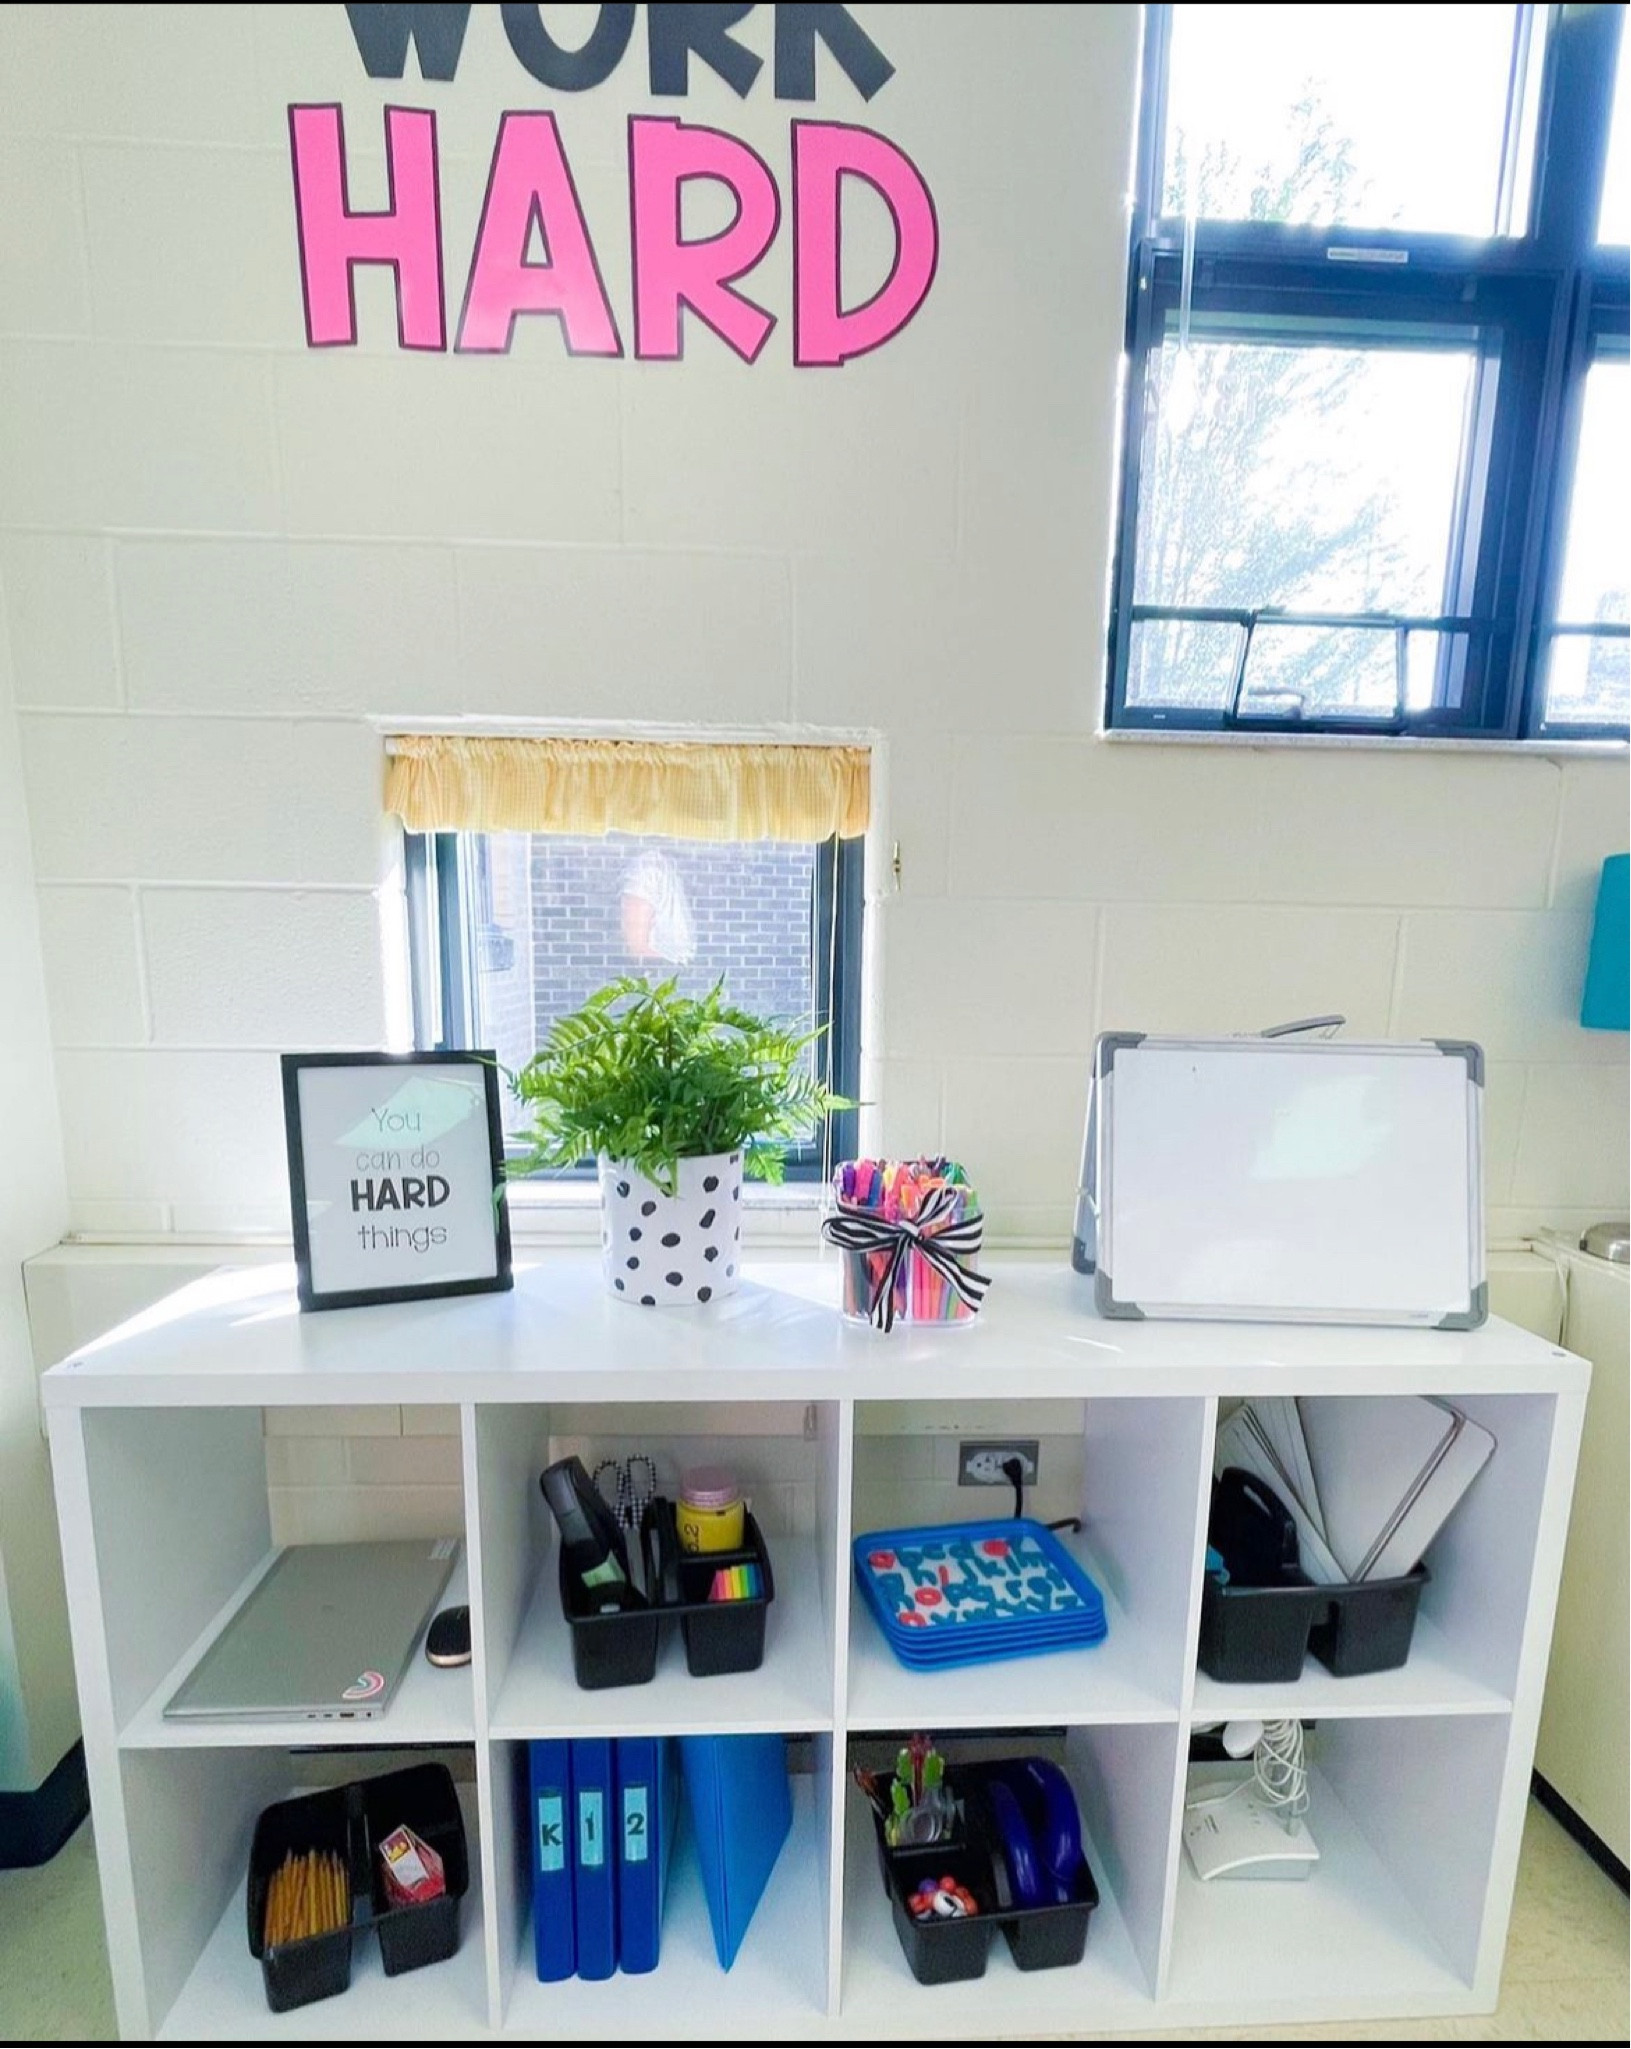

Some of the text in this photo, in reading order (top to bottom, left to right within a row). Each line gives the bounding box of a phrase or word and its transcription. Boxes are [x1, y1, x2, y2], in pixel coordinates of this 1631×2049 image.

[287, 103, 939, 367] HARD
[372, 1107, 422, 1132] You
[356, 1144, 440, 1172] can do
[350, 1175, 451, 1212] HARD
[358, 1224, 448, 1254] things
[541, 1823, 562, 1847] K
[585, 1811, 595, 1841] 1
[626, 1812, 645, 1836] 2
